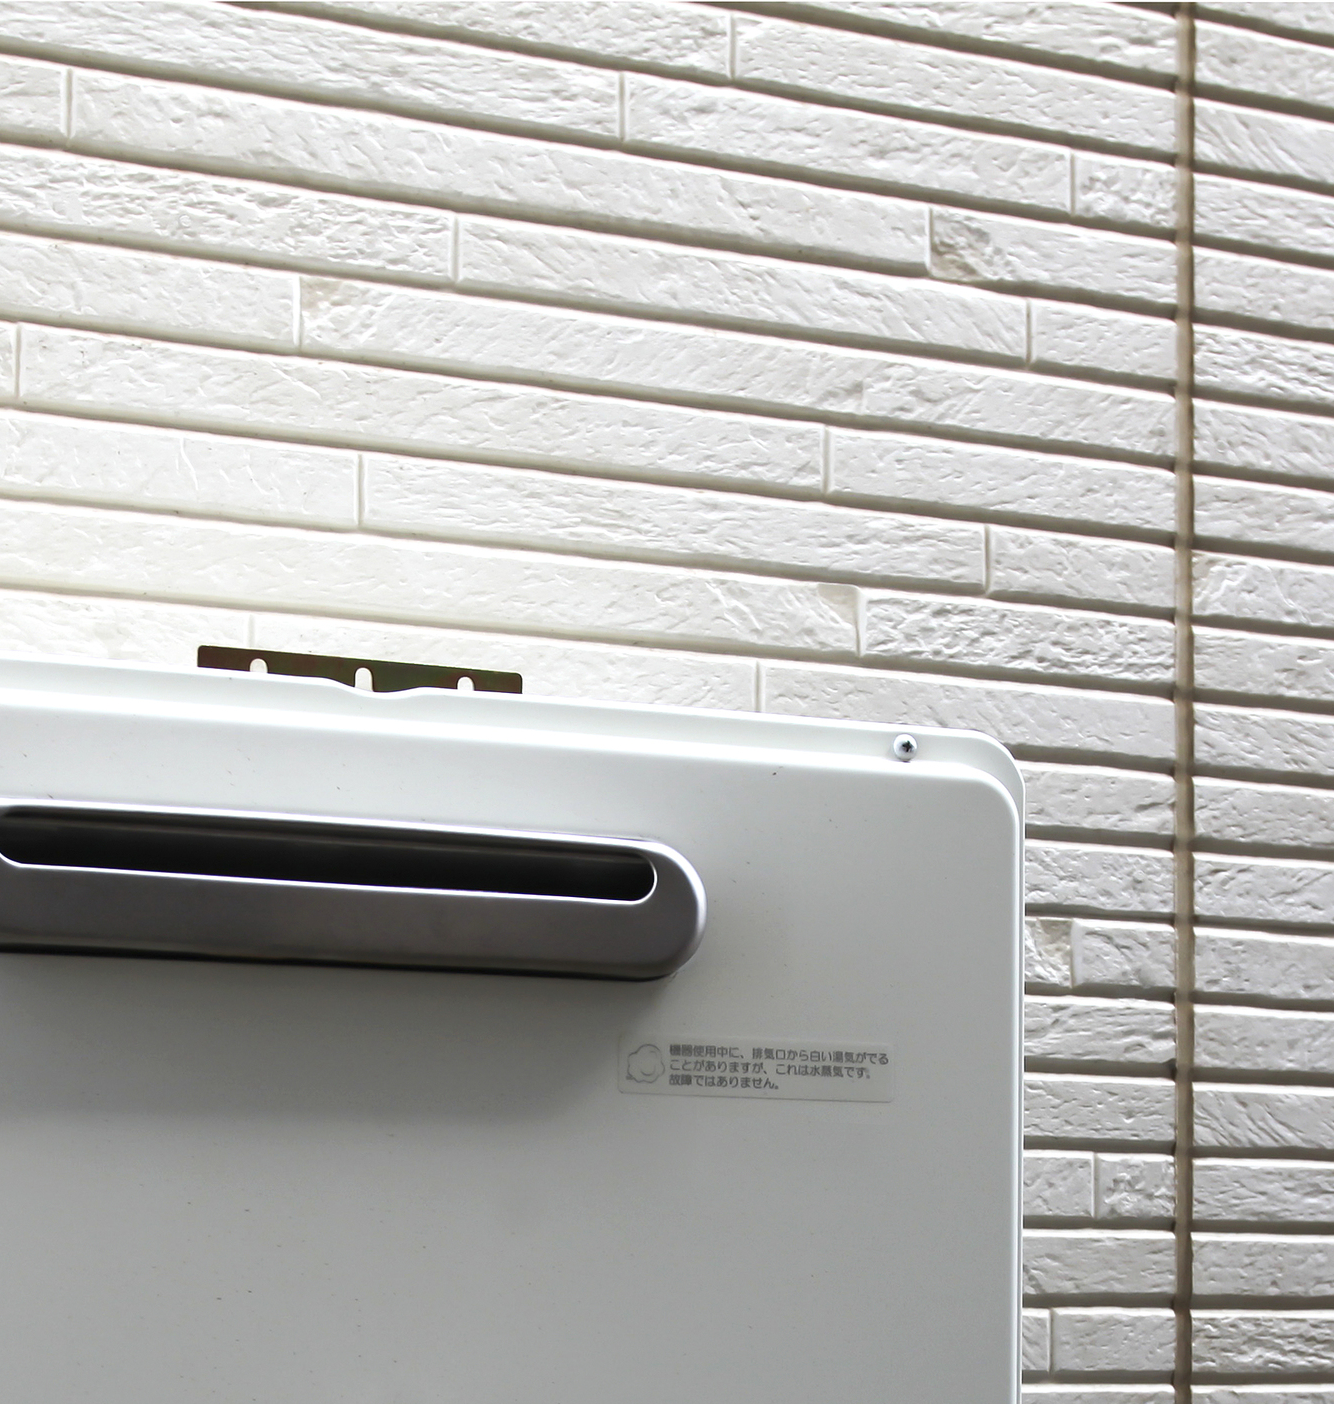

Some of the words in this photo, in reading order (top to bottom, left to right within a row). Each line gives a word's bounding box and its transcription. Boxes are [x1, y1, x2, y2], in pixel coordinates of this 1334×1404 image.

[670, 1059, 871, 1079] ことがありますが、これは水蒸気です。
[669, 1074, 779, 1090] 故障ではありません。
